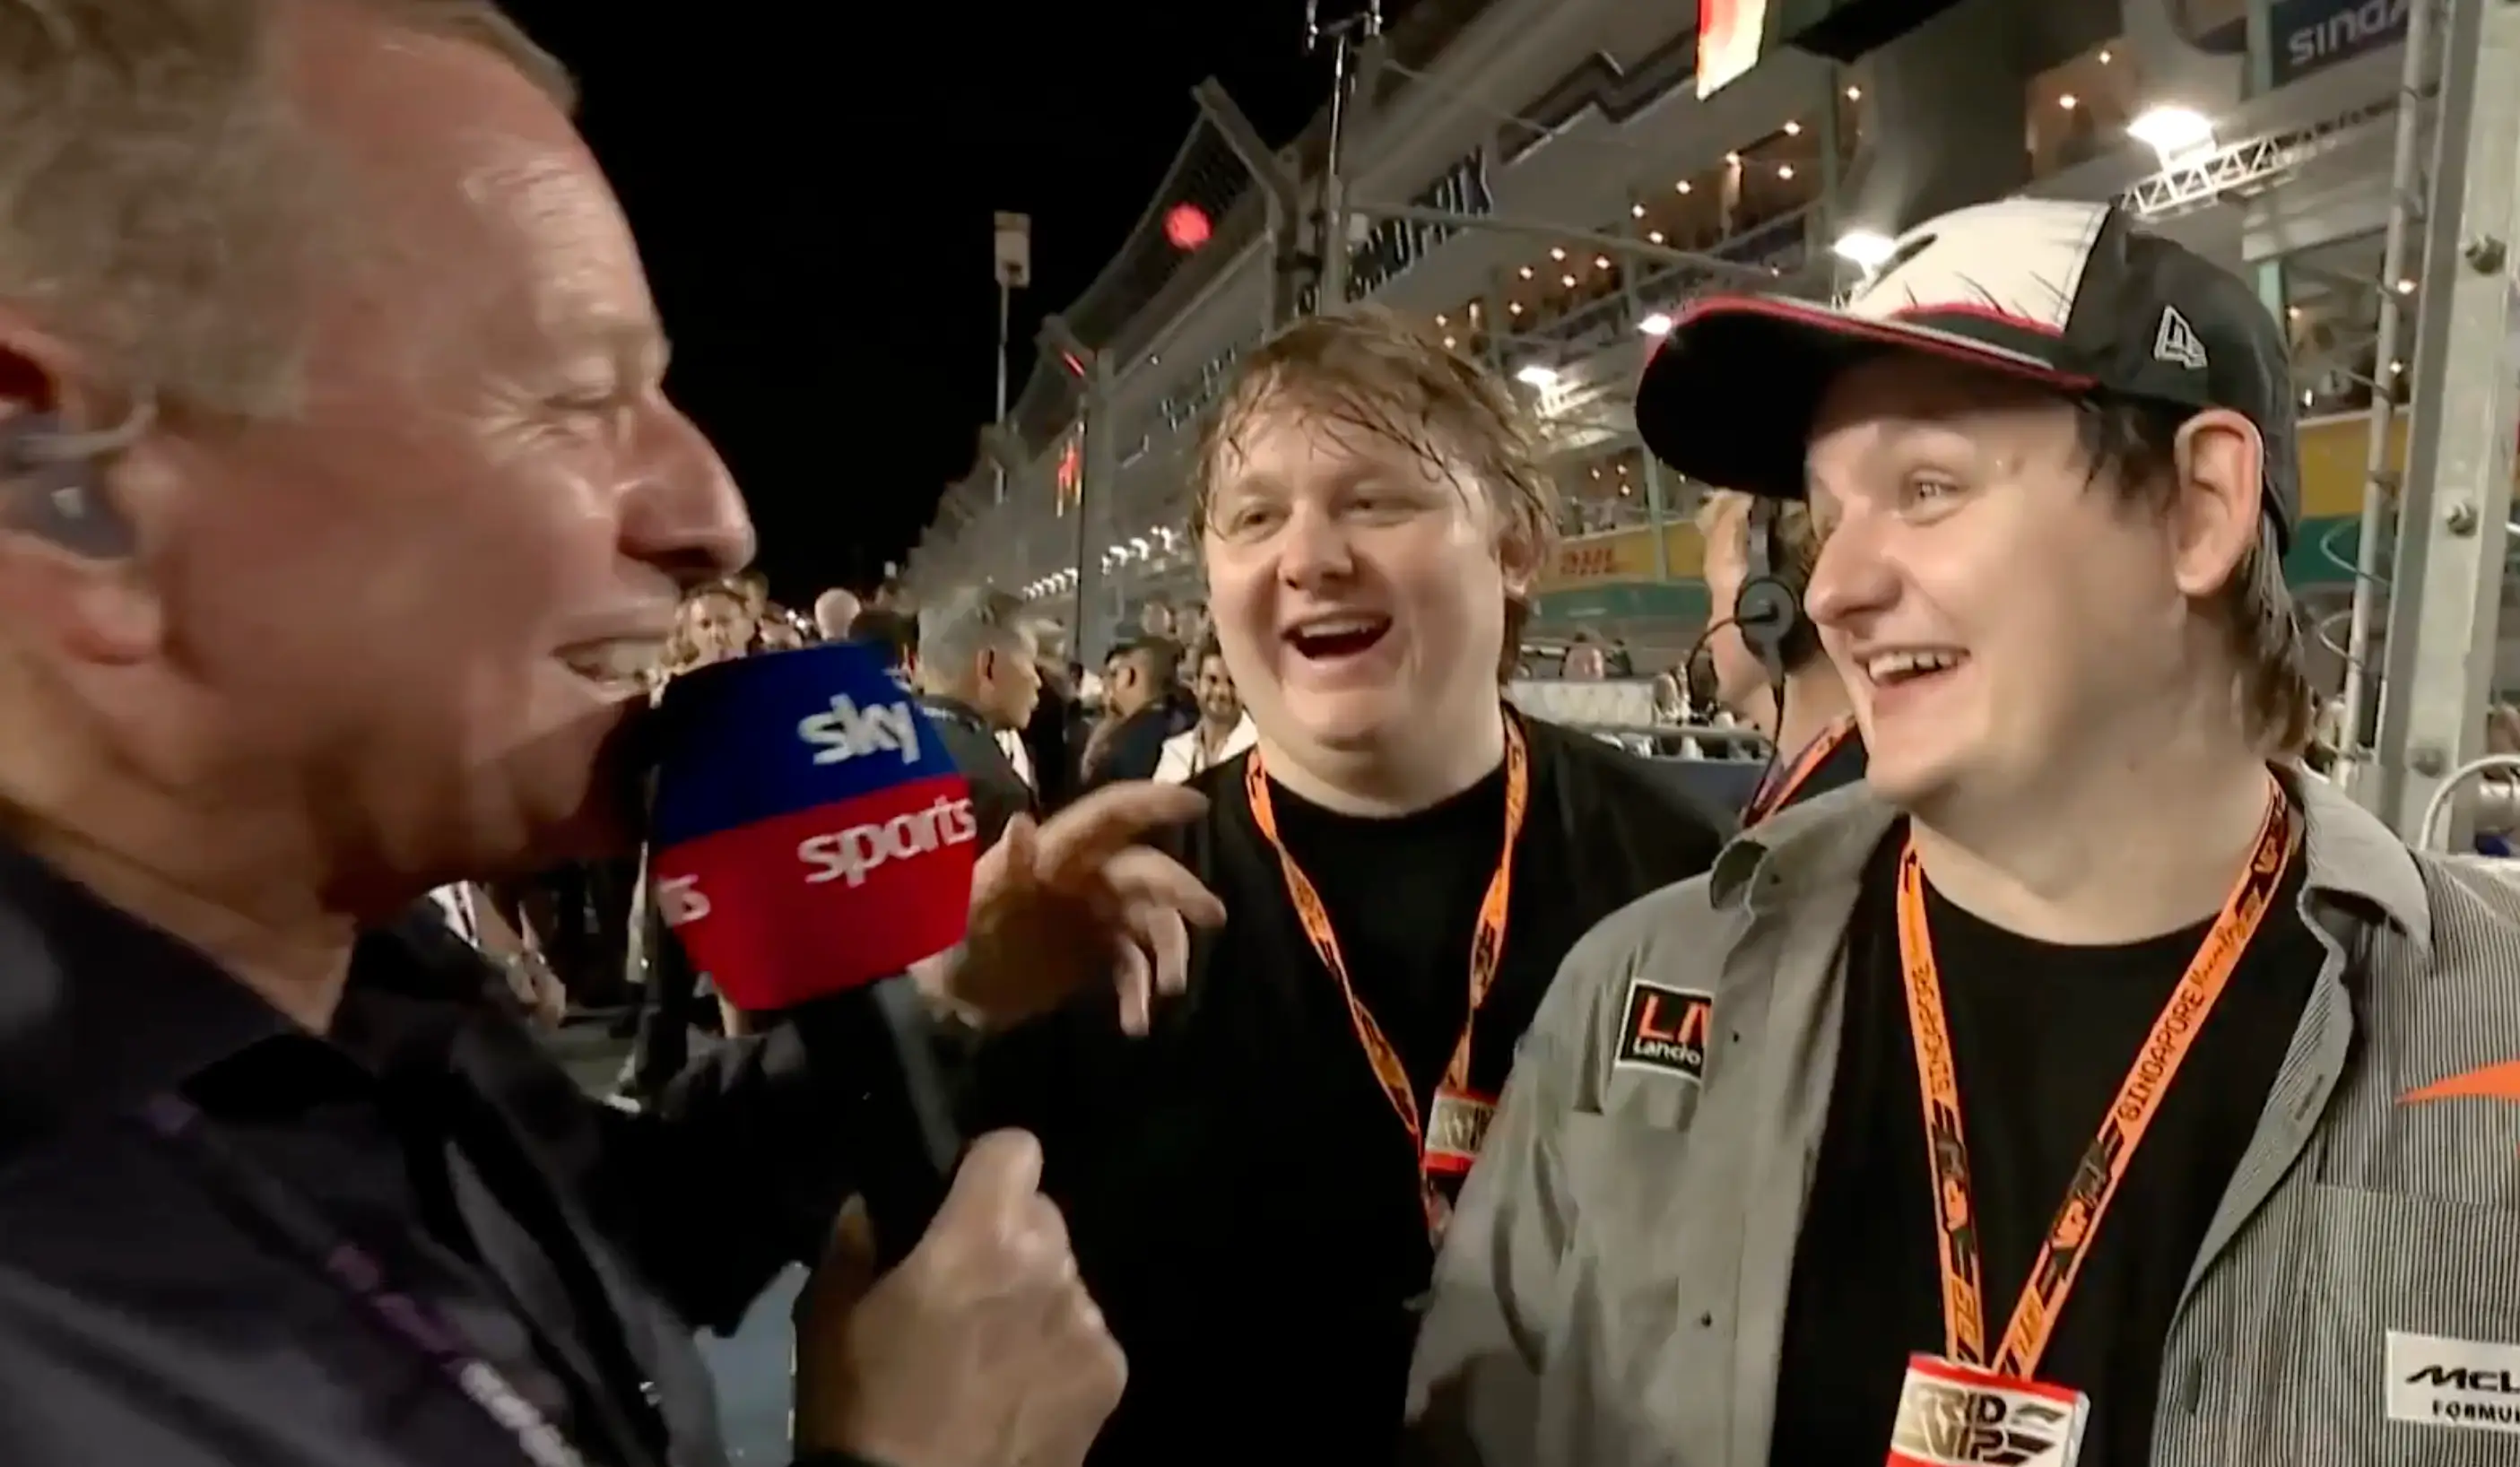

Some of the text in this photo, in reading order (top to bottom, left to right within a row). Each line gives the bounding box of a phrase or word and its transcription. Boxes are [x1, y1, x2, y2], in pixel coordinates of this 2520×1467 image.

[797, 692, 921, 765] sky
[797, 794, 978, 888] sports
[1632, 1037, 1701, 1065] Lando
[2116, 986, 2206, 1124] SINGAPORE
